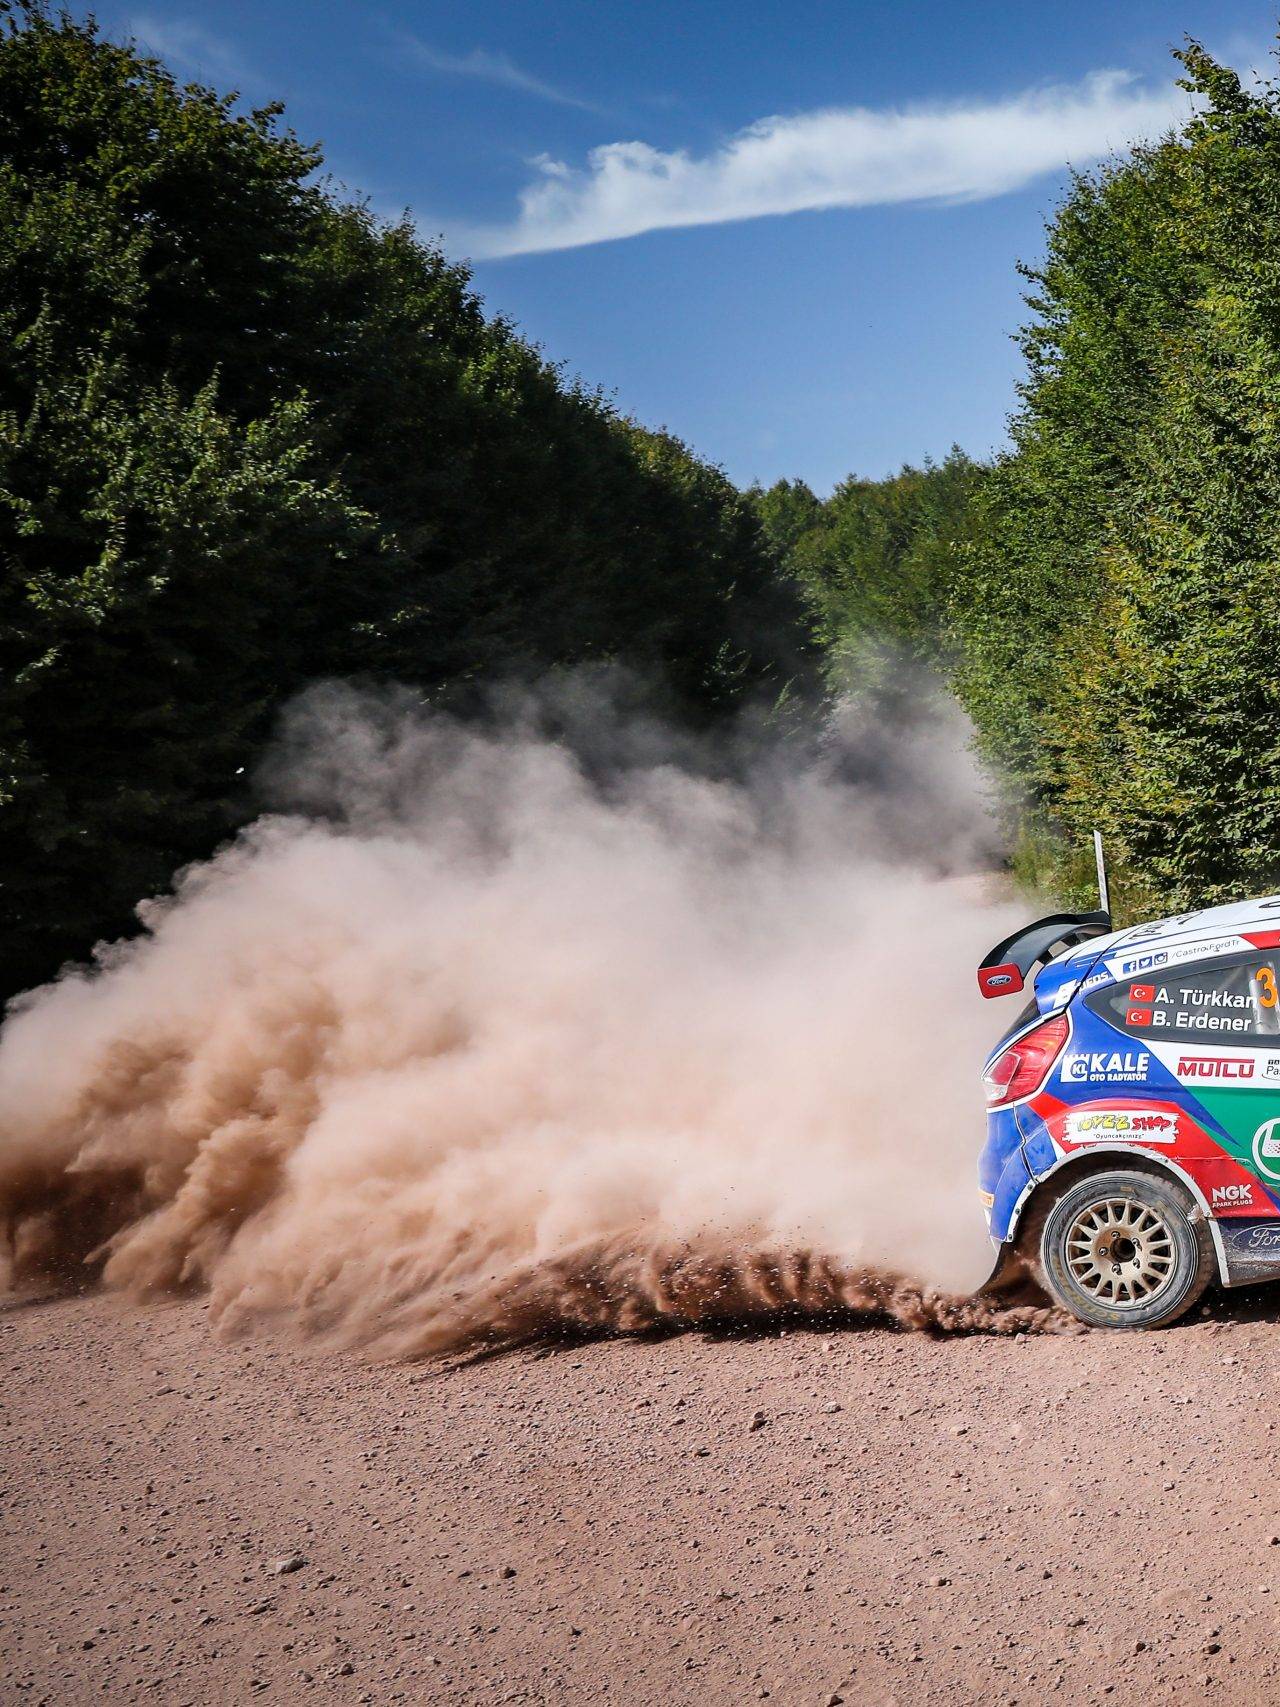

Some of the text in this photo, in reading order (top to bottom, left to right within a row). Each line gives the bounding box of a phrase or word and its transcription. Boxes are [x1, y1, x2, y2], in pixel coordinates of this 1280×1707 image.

[1256, 967, 1279, 1008] 3
[1155, 988, 1257, 1009] A. Türkkan
[1152, 1011, 1252, 1031] B. Erdener
[1090, 1053, 1150, 1072] KALE
[1177, 1057, 1254, 1078] MUTLU
[1107, 1071, 1147, 1082] RADYATÖR
[1211, 1184, 1252, 1202] NGK
